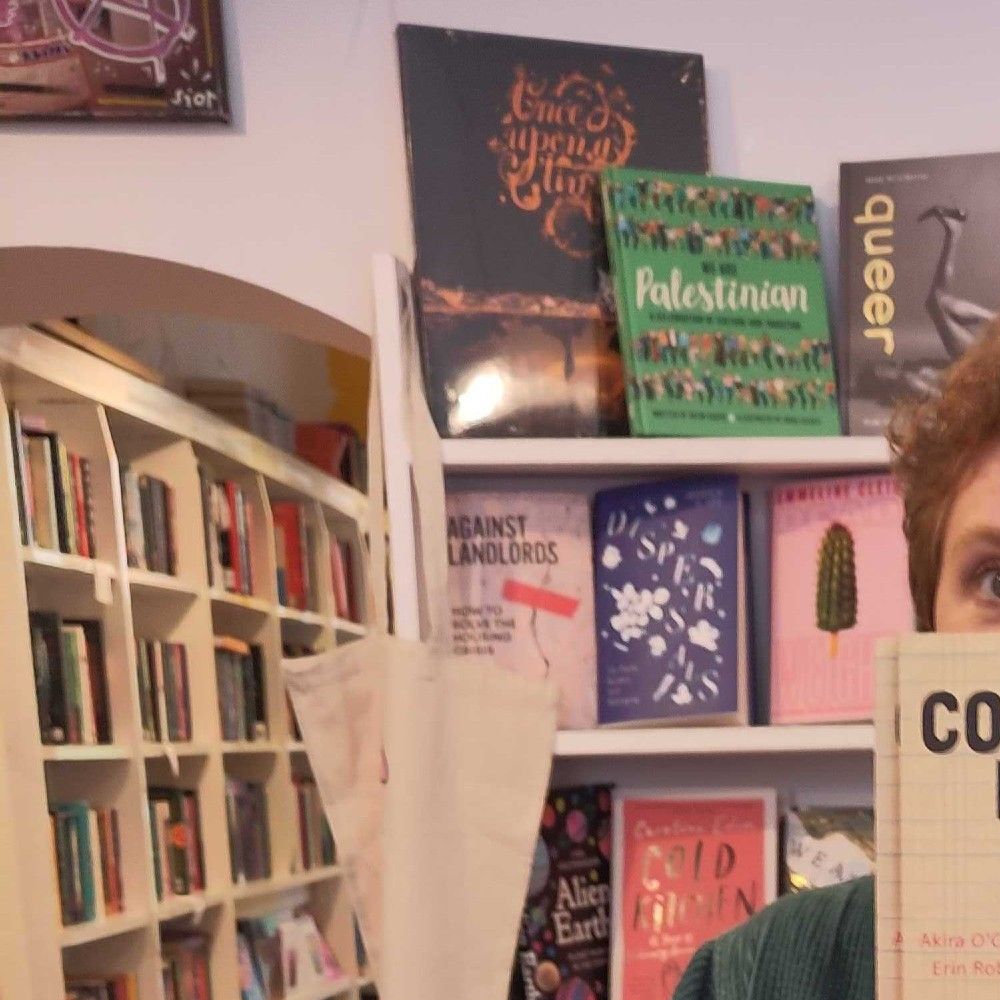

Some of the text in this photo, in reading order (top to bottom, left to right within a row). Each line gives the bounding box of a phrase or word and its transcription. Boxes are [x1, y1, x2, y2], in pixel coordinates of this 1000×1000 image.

[853, 194, 895, 355] queer
[635, 266, 808, 313] Palestinian
[447, 514, 526, 539] AGAINST
[448, 541, 559, 566] LANDLORDS
[920, 931, 965, 947] Akira
[932, 960, 968, 977] Erin
